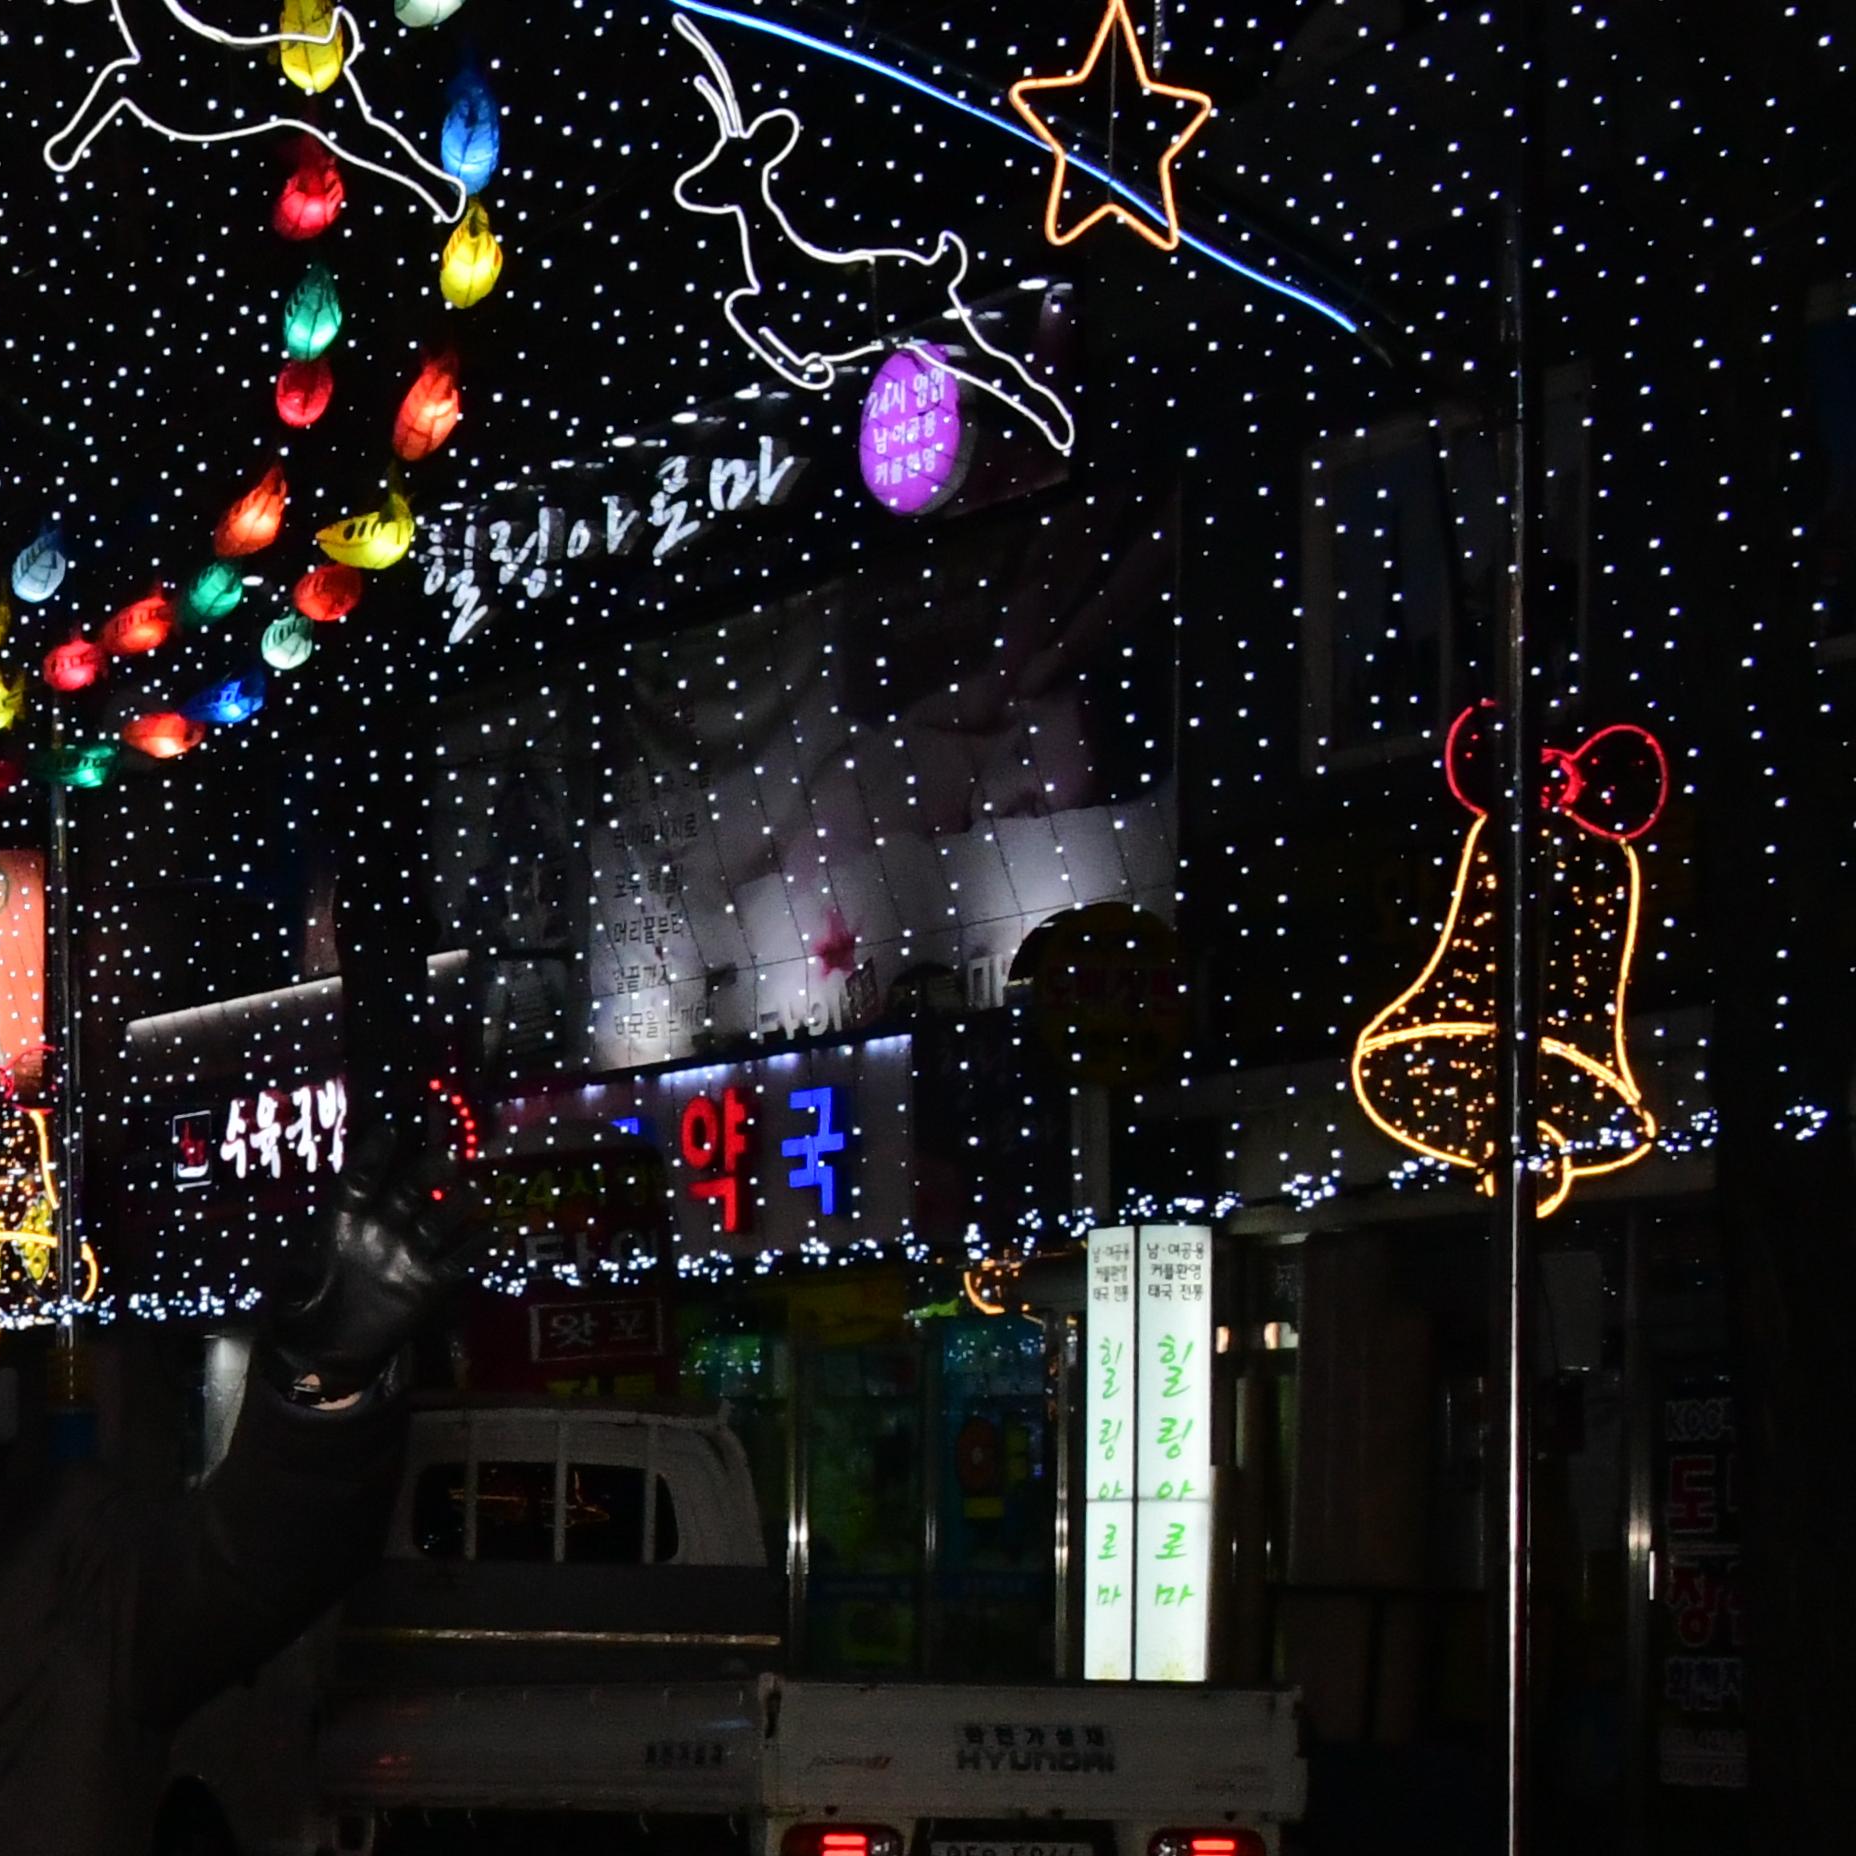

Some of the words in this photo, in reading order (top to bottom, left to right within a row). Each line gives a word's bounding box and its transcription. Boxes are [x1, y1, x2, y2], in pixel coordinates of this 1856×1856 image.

[681, 1085, 846, 1233] 약국
[1150, 1262, 1202, 1281] 커플환영
[1147, 1283, 1173, 1301] 태국
